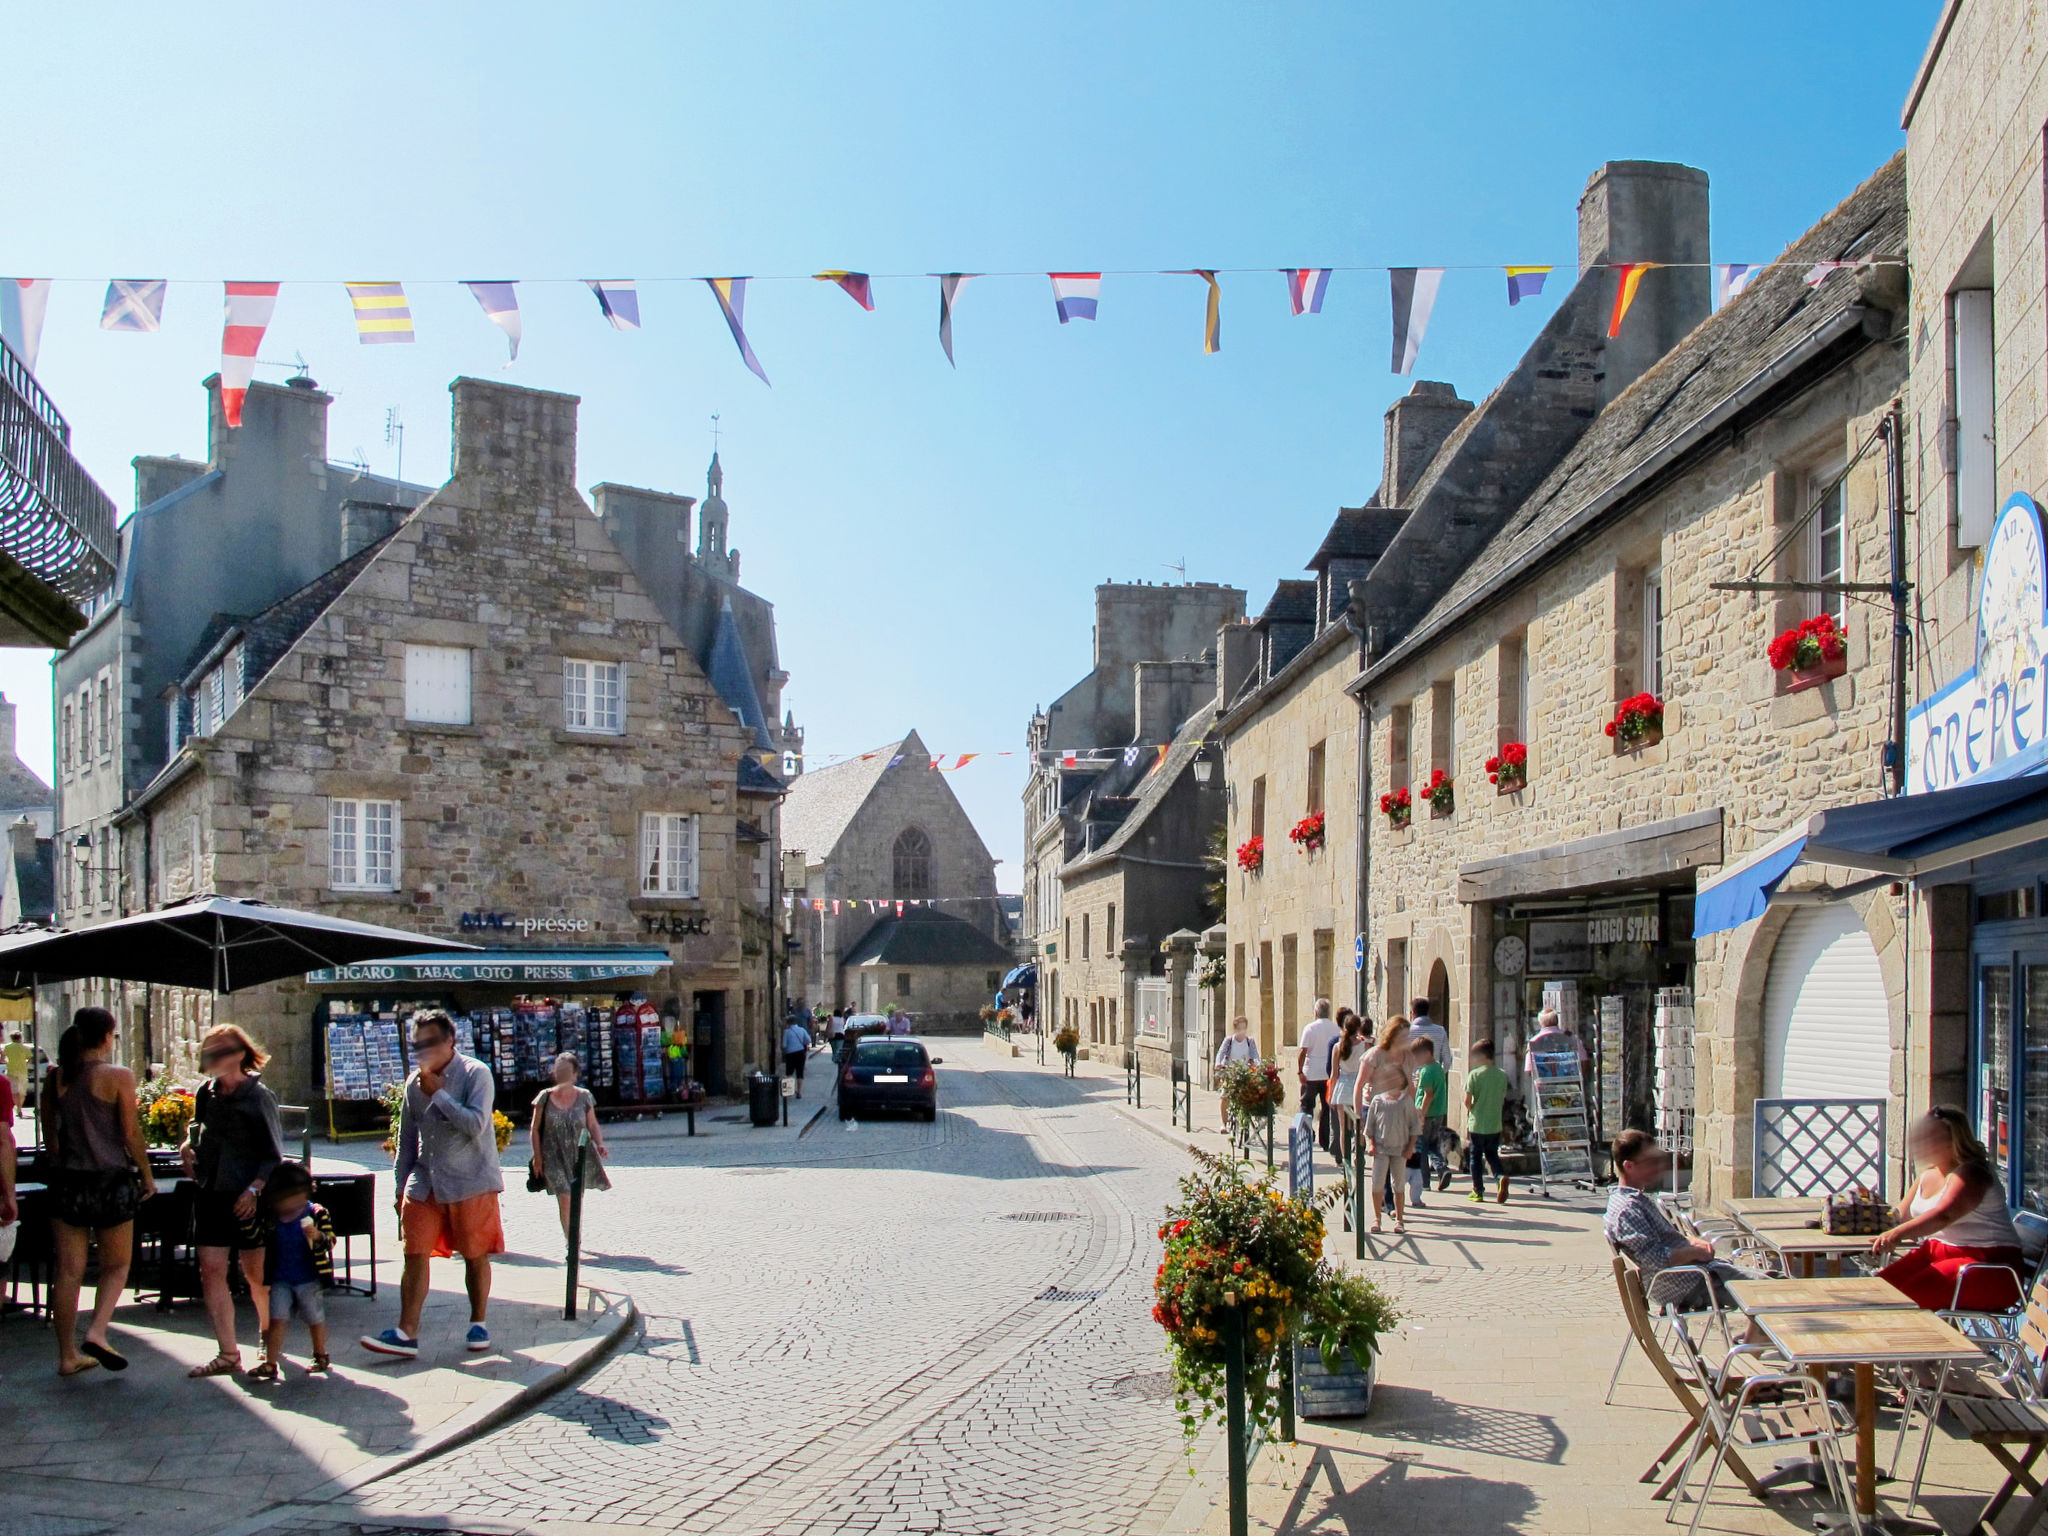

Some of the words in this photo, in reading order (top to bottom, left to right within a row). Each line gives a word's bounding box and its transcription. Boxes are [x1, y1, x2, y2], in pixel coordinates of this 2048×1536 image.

[524, 917, 588, 937] presse
[642, 915, 710, 935] TABAC
[1587, 917, 1624, 944] CARGO
[1627, 915, 1660, 942] STAR
[310, 969, 327, 980] LE
[335, 966, 395, 980] FIGARO
[413, 966, 462, 979] TABAC
[473, 966, 513, 980] LOTO
[523, 965, 574, 980] PRESSE
[590, 966, 606, 978] LE
